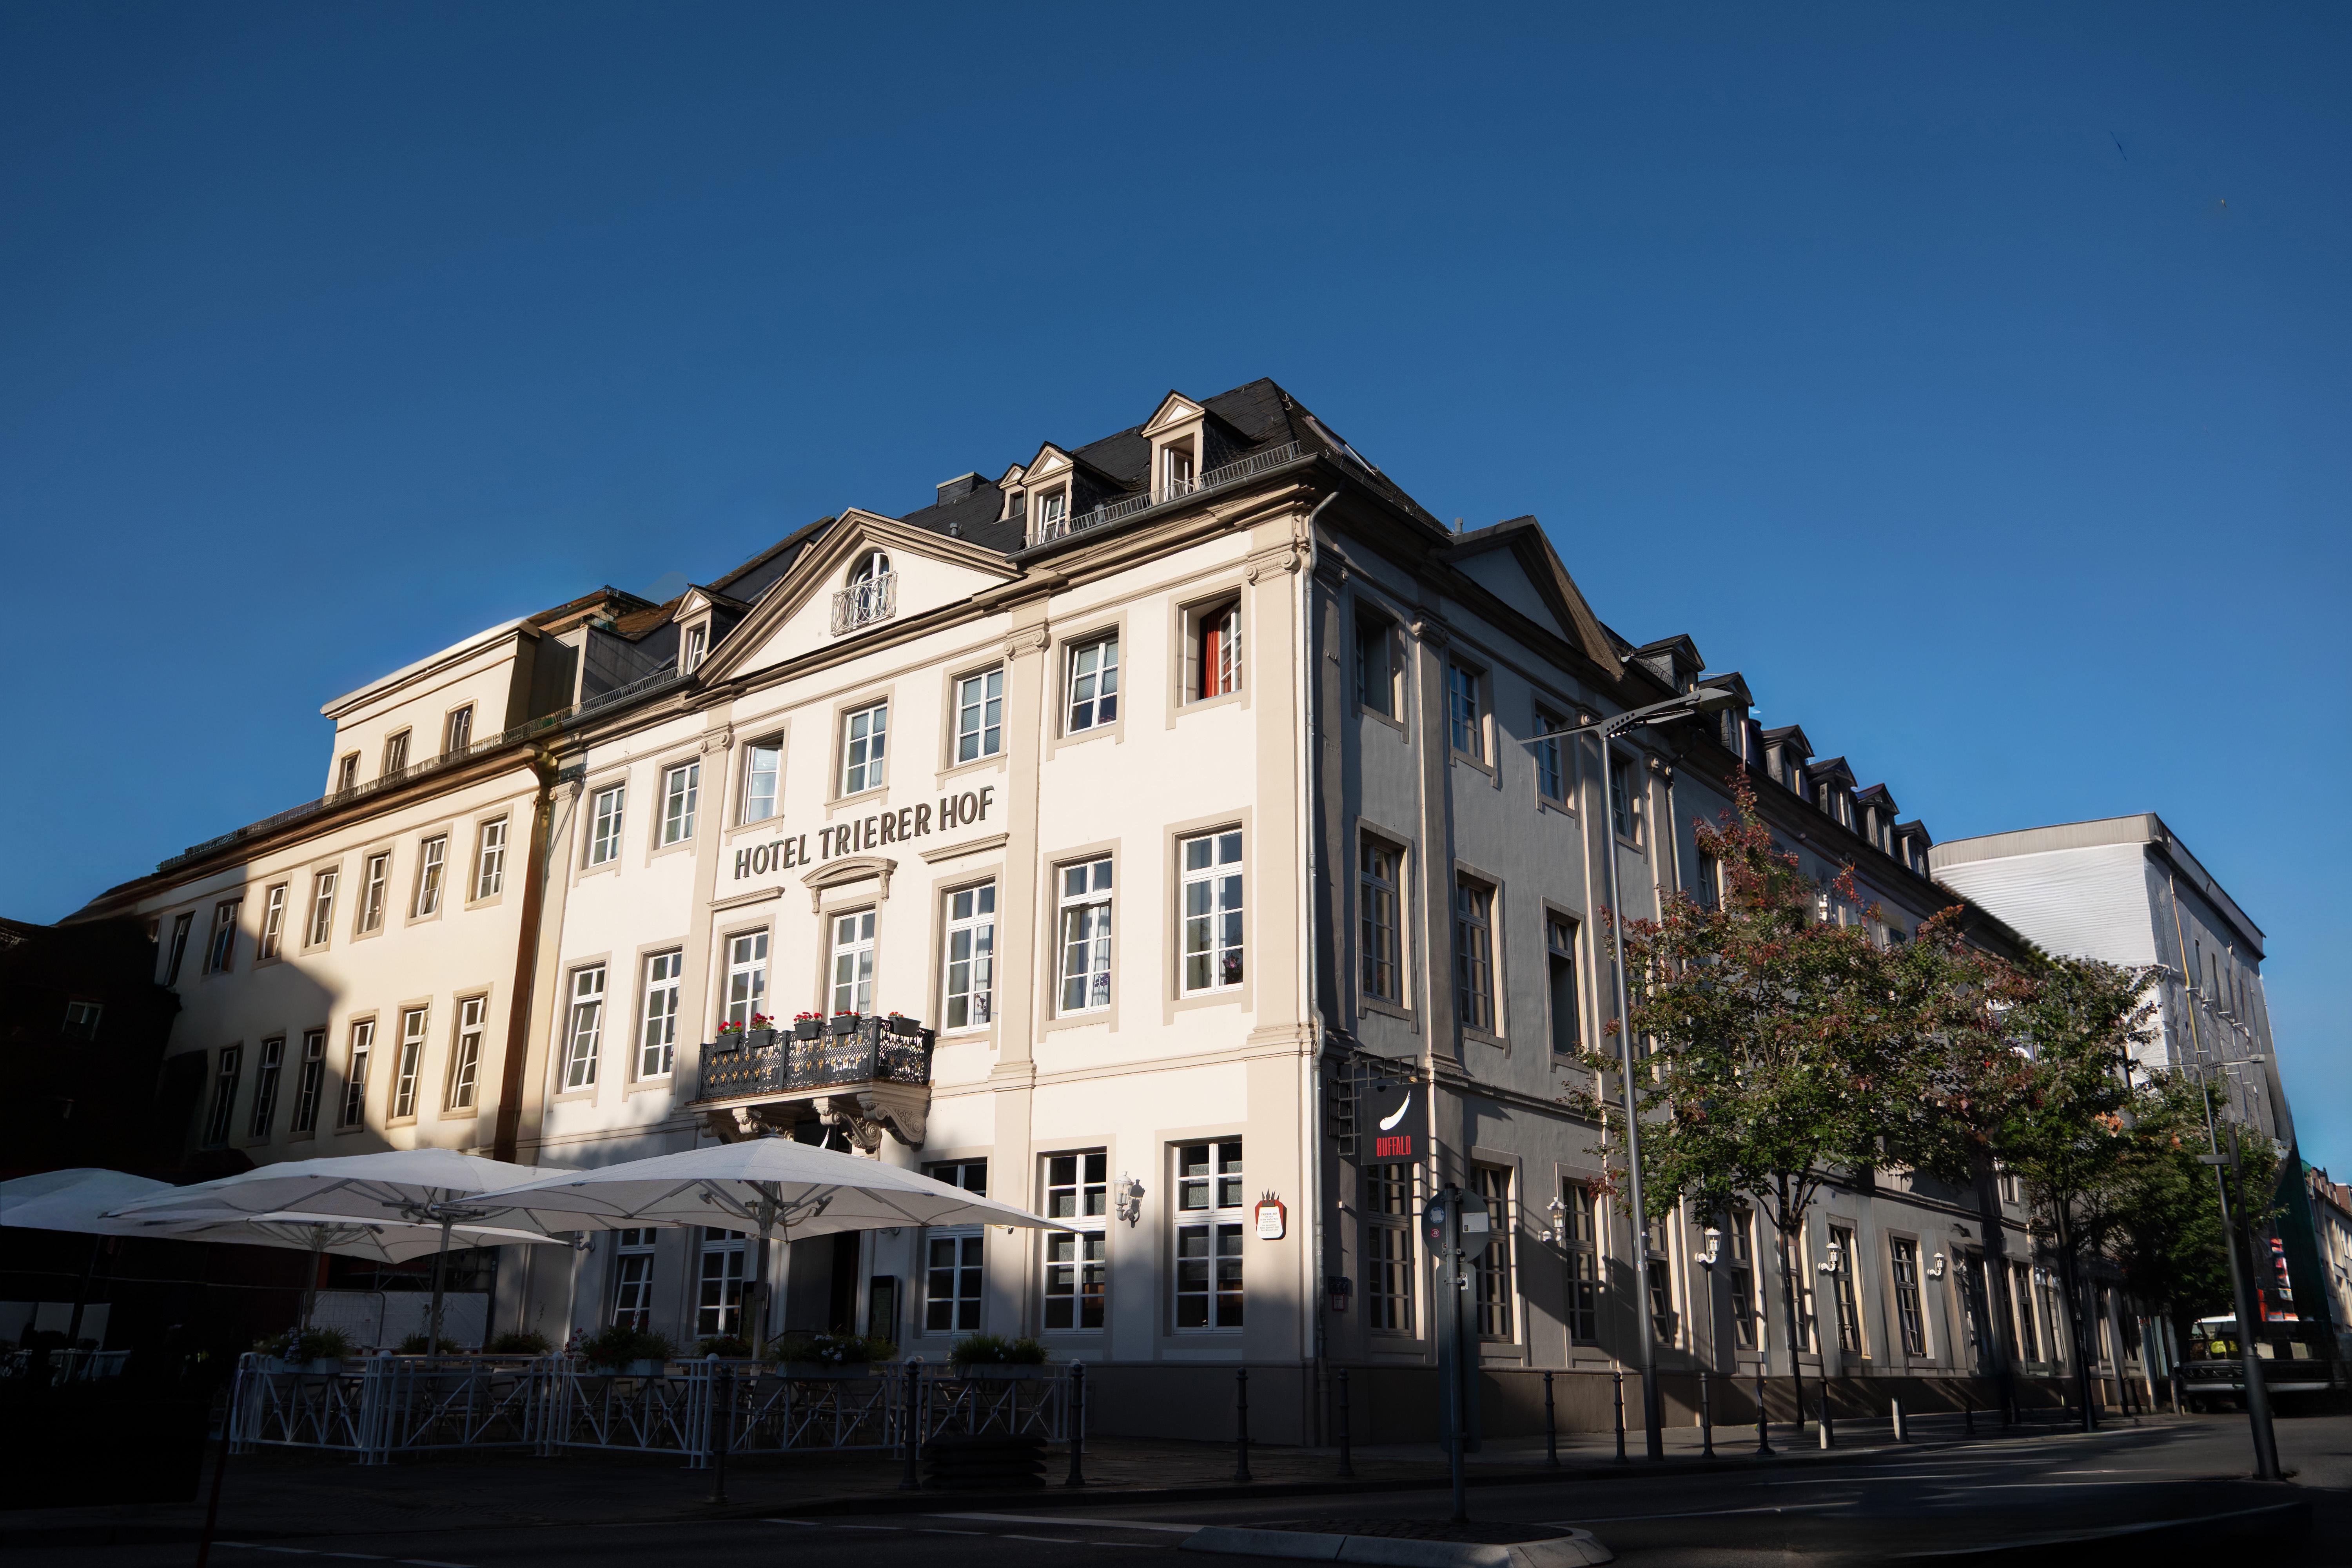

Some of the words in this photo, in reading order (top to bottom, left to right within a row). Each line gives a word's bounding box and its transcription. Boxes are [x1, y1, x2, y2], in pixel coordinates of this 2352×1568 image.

[735, 834, 811, 879] HOTEL
[818, 803, 931, 859] TRIERER
[939, 785, 995, 831] HOF
[1377, 1135, 1411, 1157] BUFFALO
